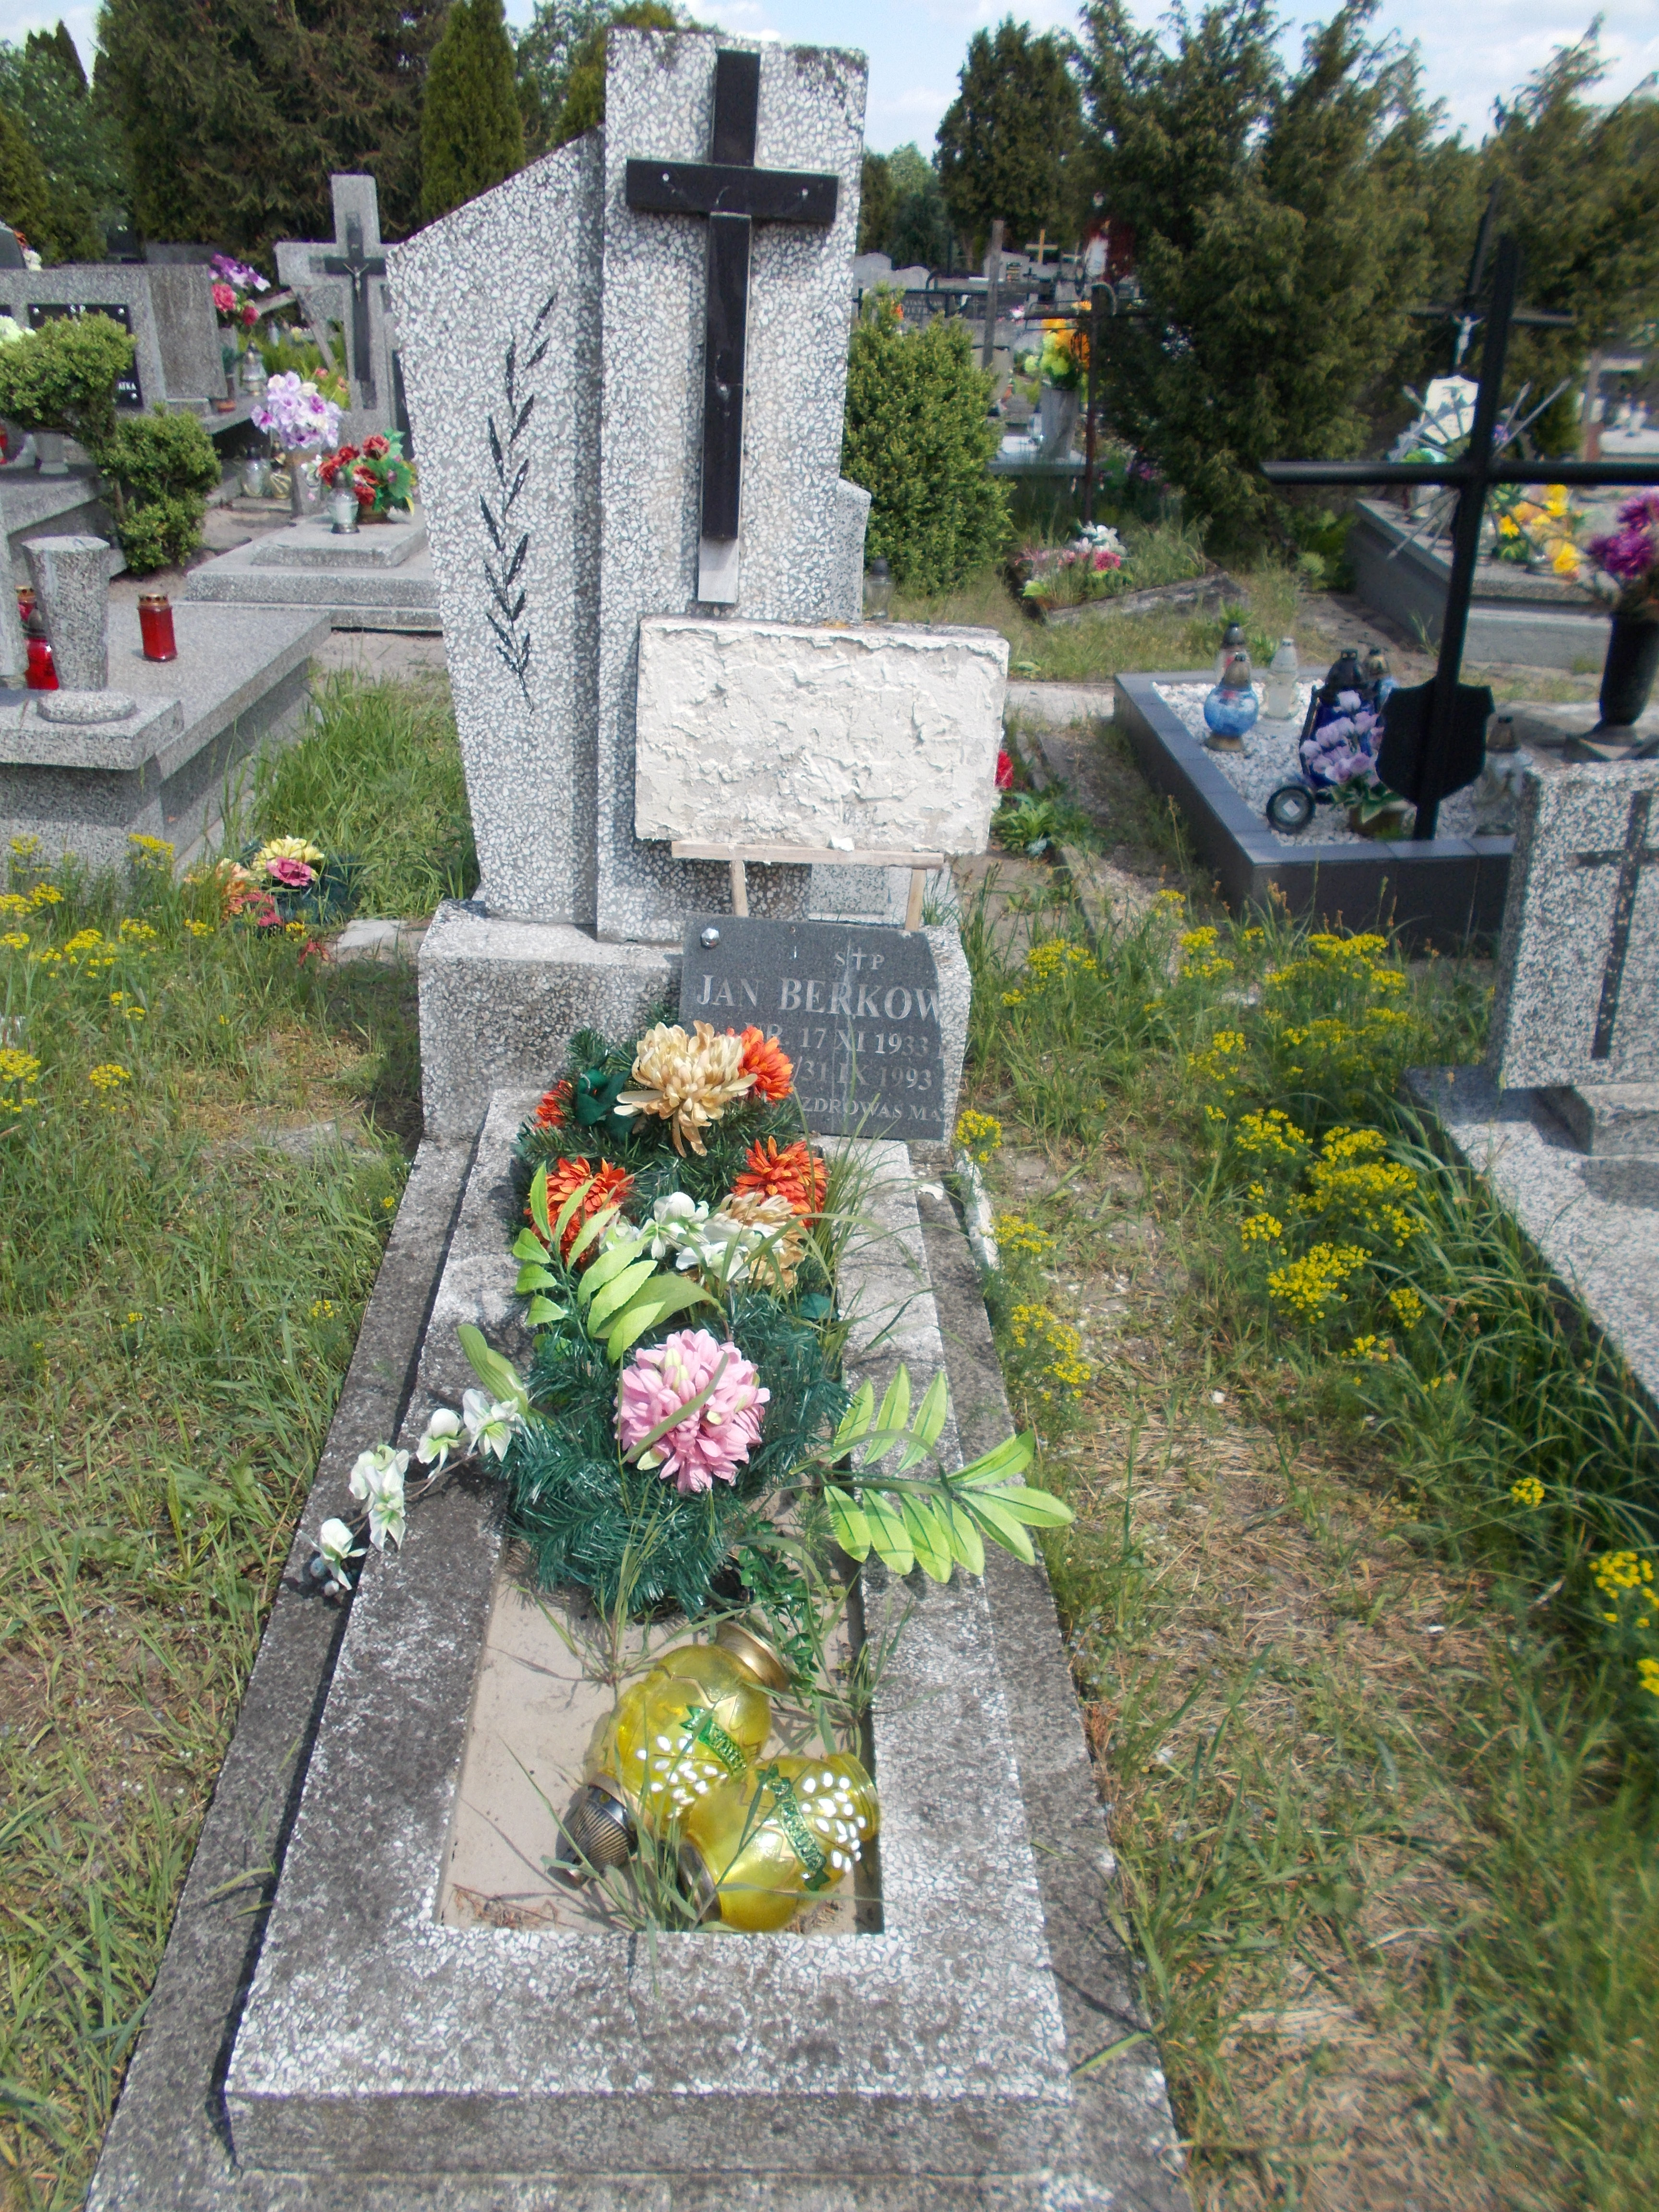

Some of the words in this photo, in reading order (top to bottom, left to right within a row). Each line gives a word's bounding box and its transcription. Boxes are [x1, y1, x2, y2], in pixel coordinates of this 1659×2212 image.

[697, 974, 764, 1007] JAN
[777, 976, 939, 1023] BERKOW
[800, 1027, 827, 1049] 17
[875, 1032, 928, 1057] 1933
[879, 1066, 932, 1091] 1993
